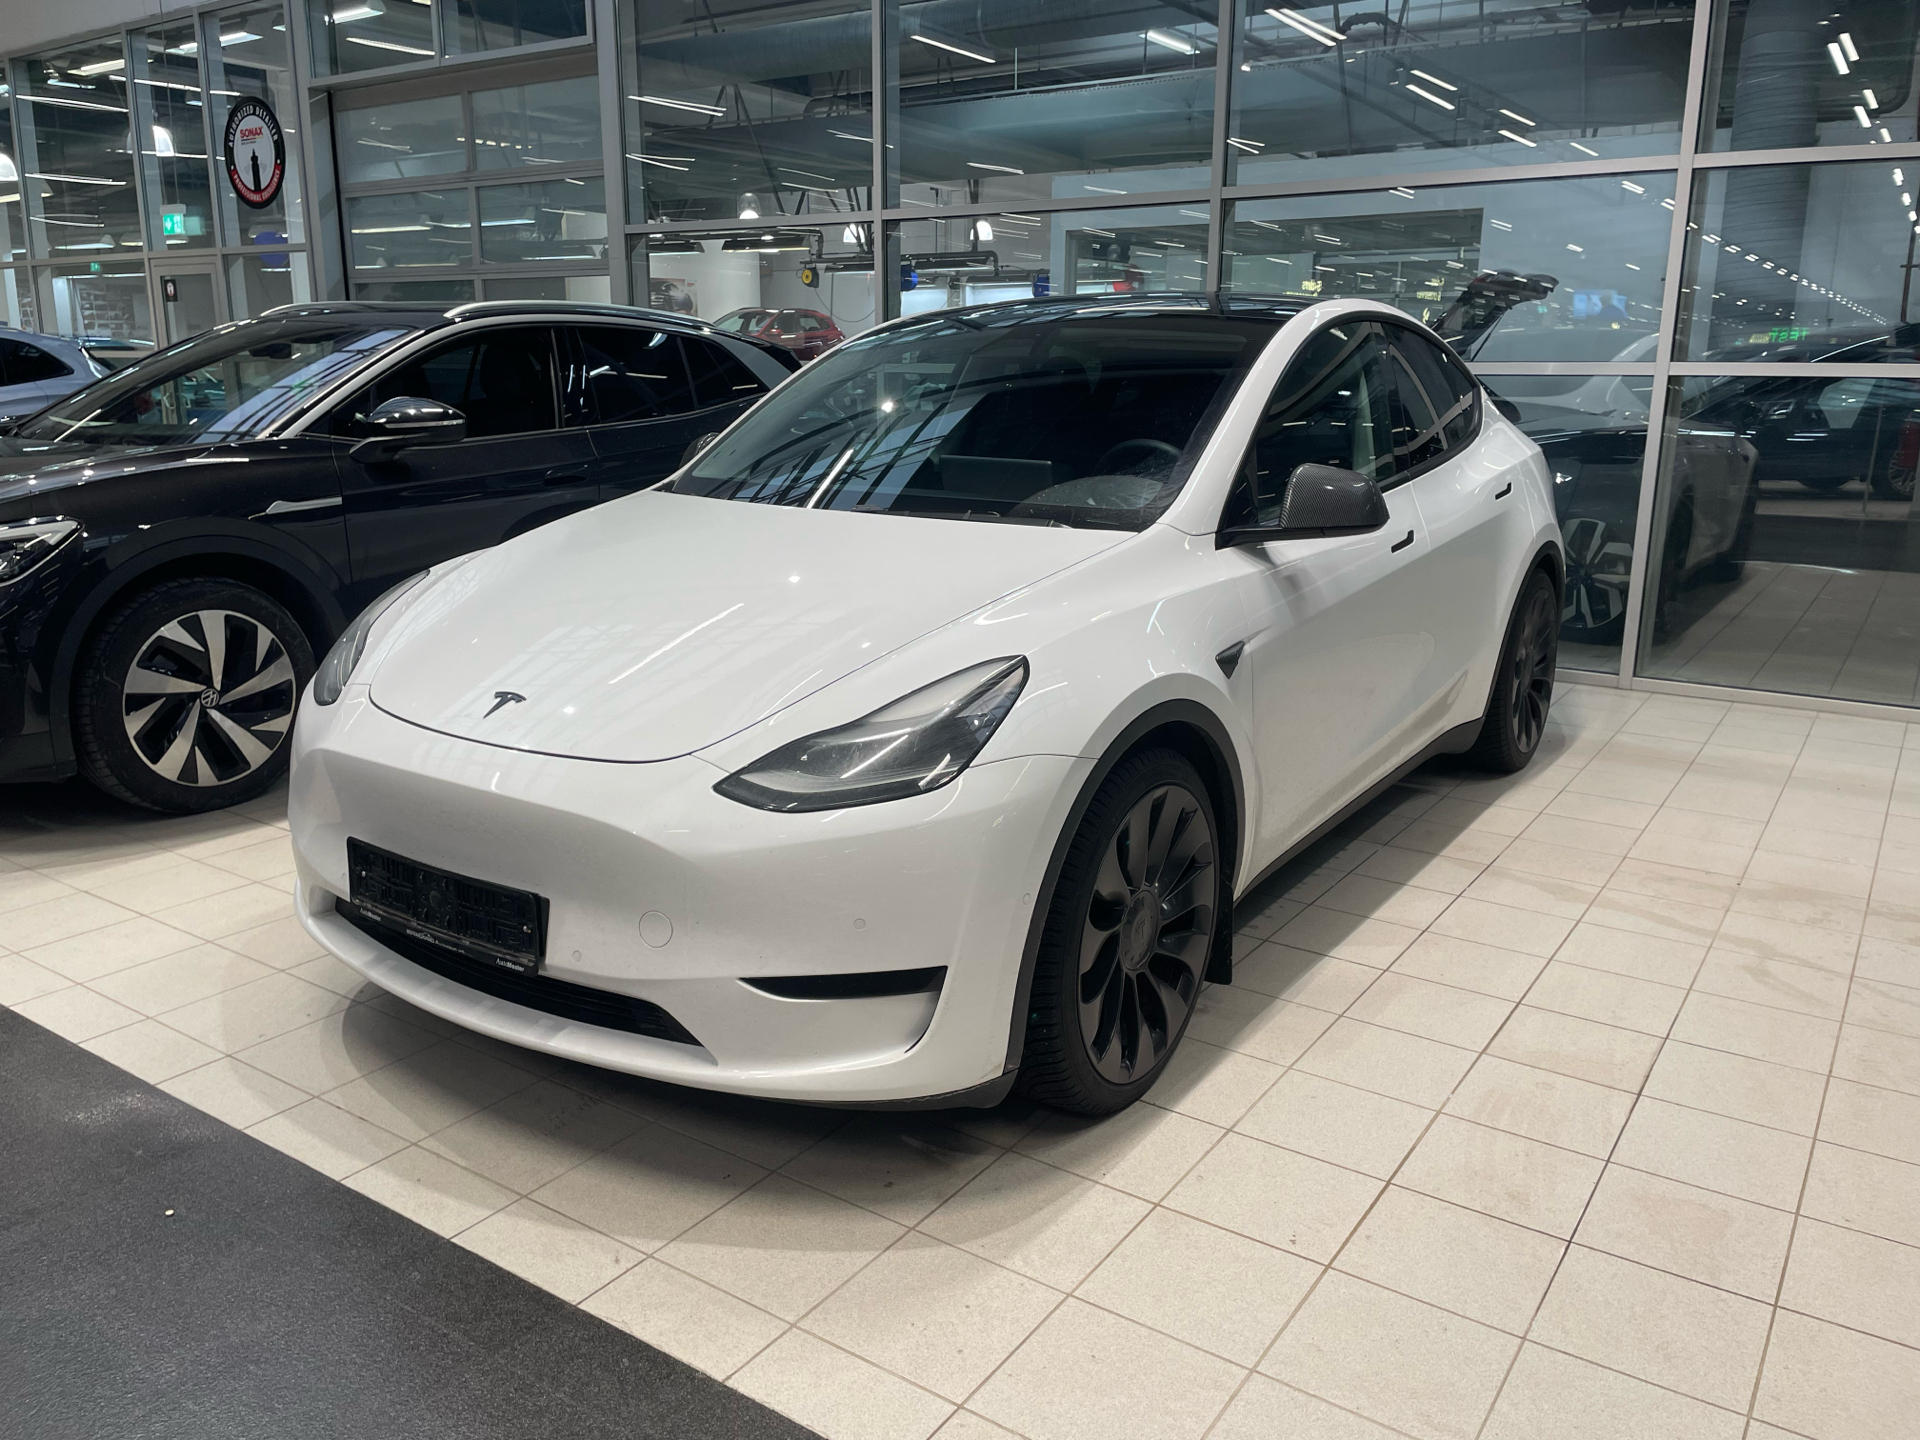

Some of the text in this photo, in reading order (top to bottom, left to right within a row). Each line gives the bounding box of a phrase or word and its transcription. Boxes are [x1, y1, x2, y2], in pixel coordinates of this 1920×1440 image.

[229, 105, 278, 148] AUTHORIZED DETAILER
[240, 127, 263, 138] SONAX
[233, 173, 262, 201] PROFESSIONAL
[496, 958, 524, 971] AutoMaster
